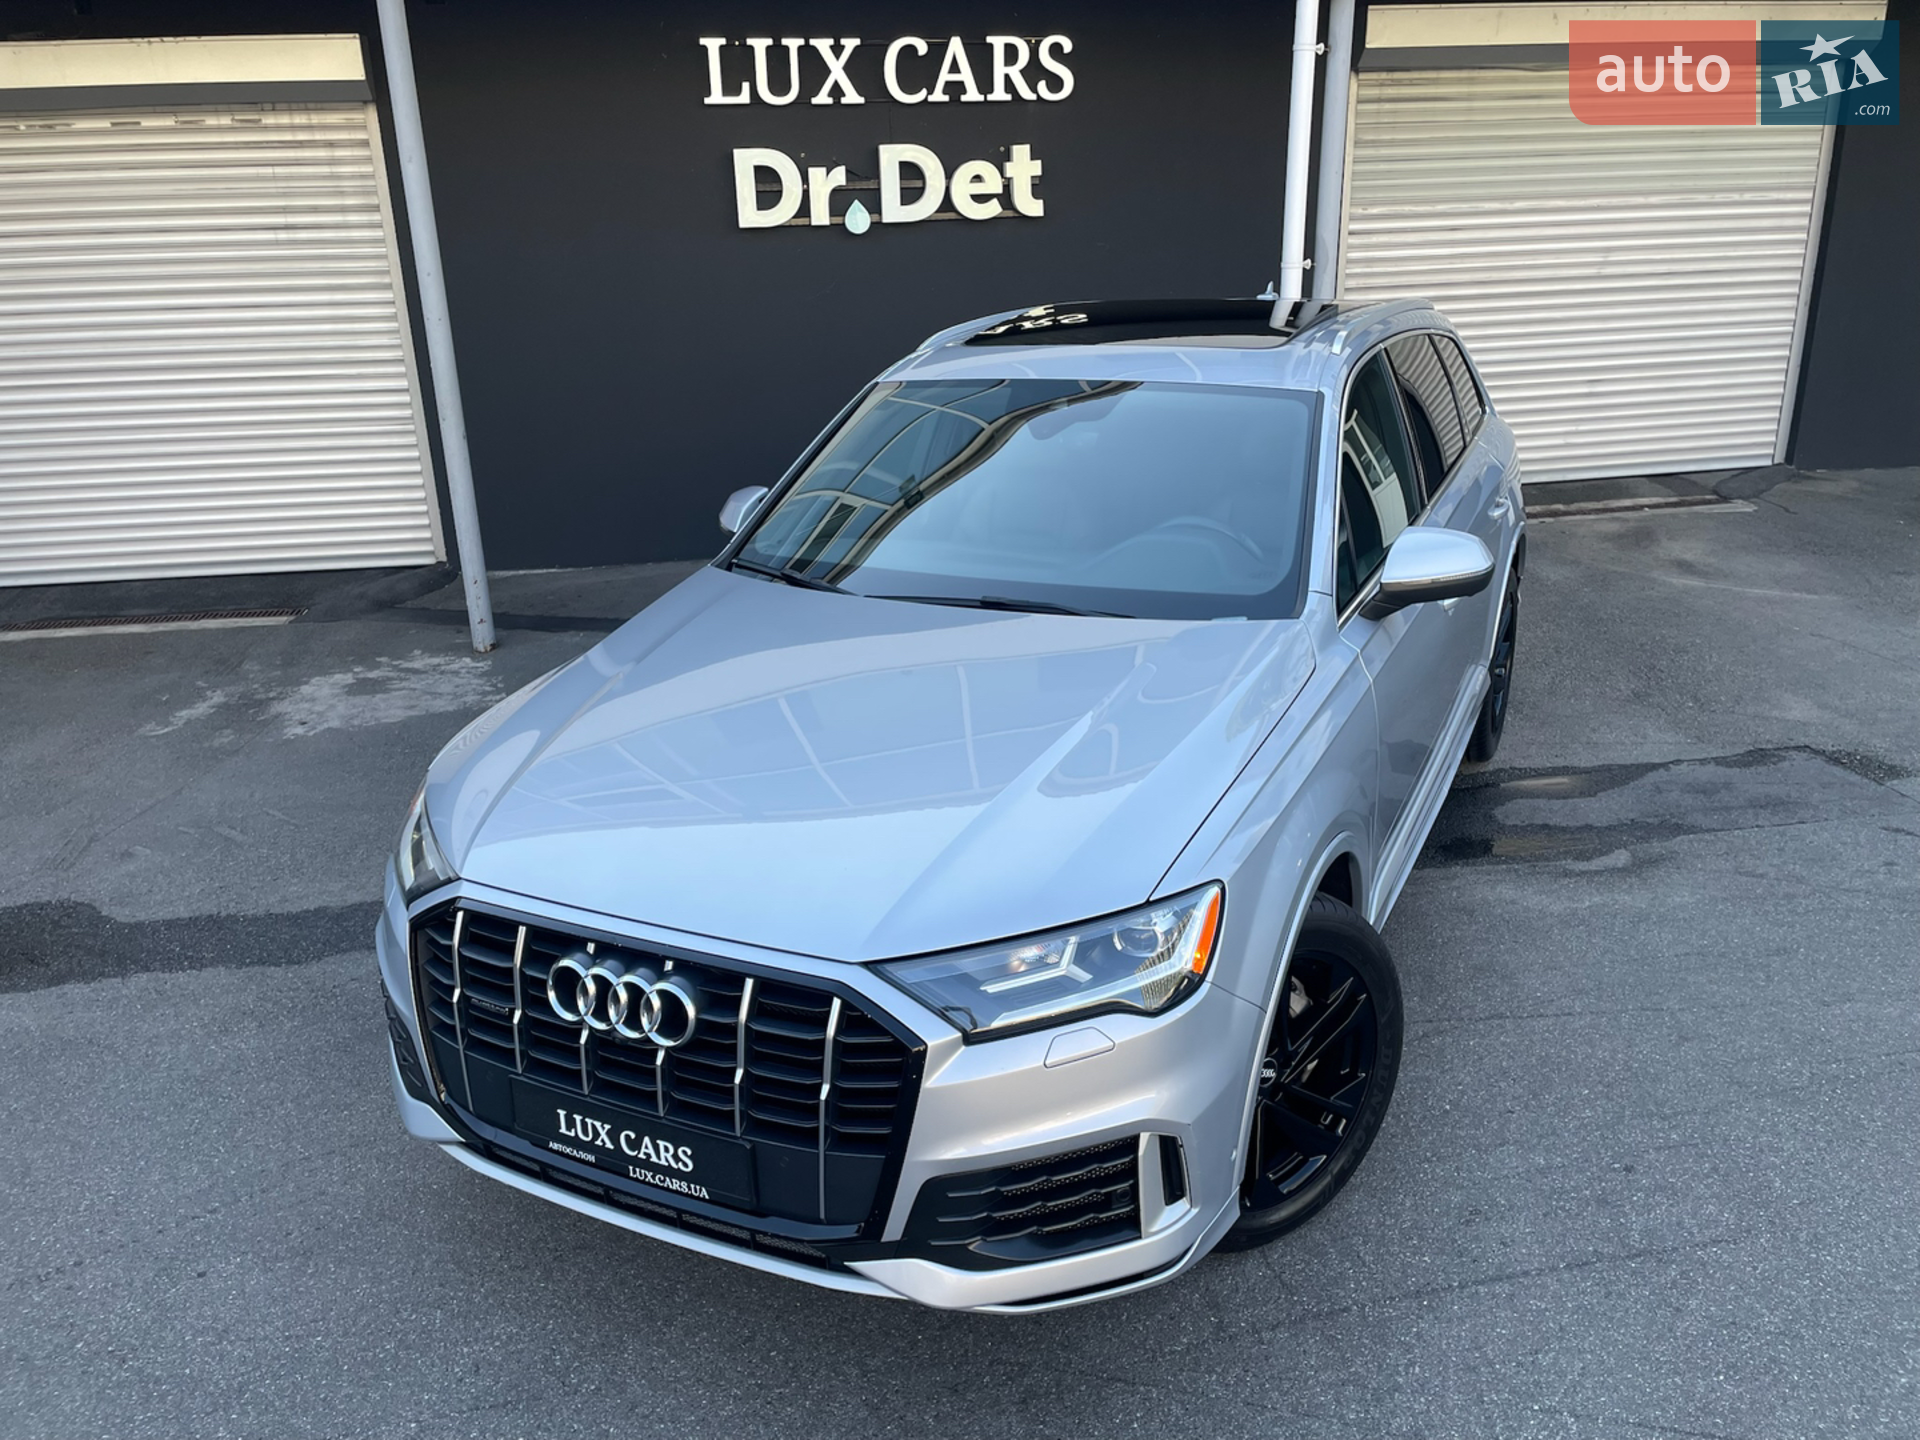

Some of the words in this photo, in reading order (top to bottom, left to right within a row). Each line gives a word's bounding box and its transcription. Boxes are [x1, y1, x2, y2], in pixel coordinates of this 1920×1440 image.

[699, 37, 865, 106] LUX
[883, 34, 1075, 104] CARS
[556, 1108, 615, 1150] LUX
[619, 1130, 694, 1173] CARS
